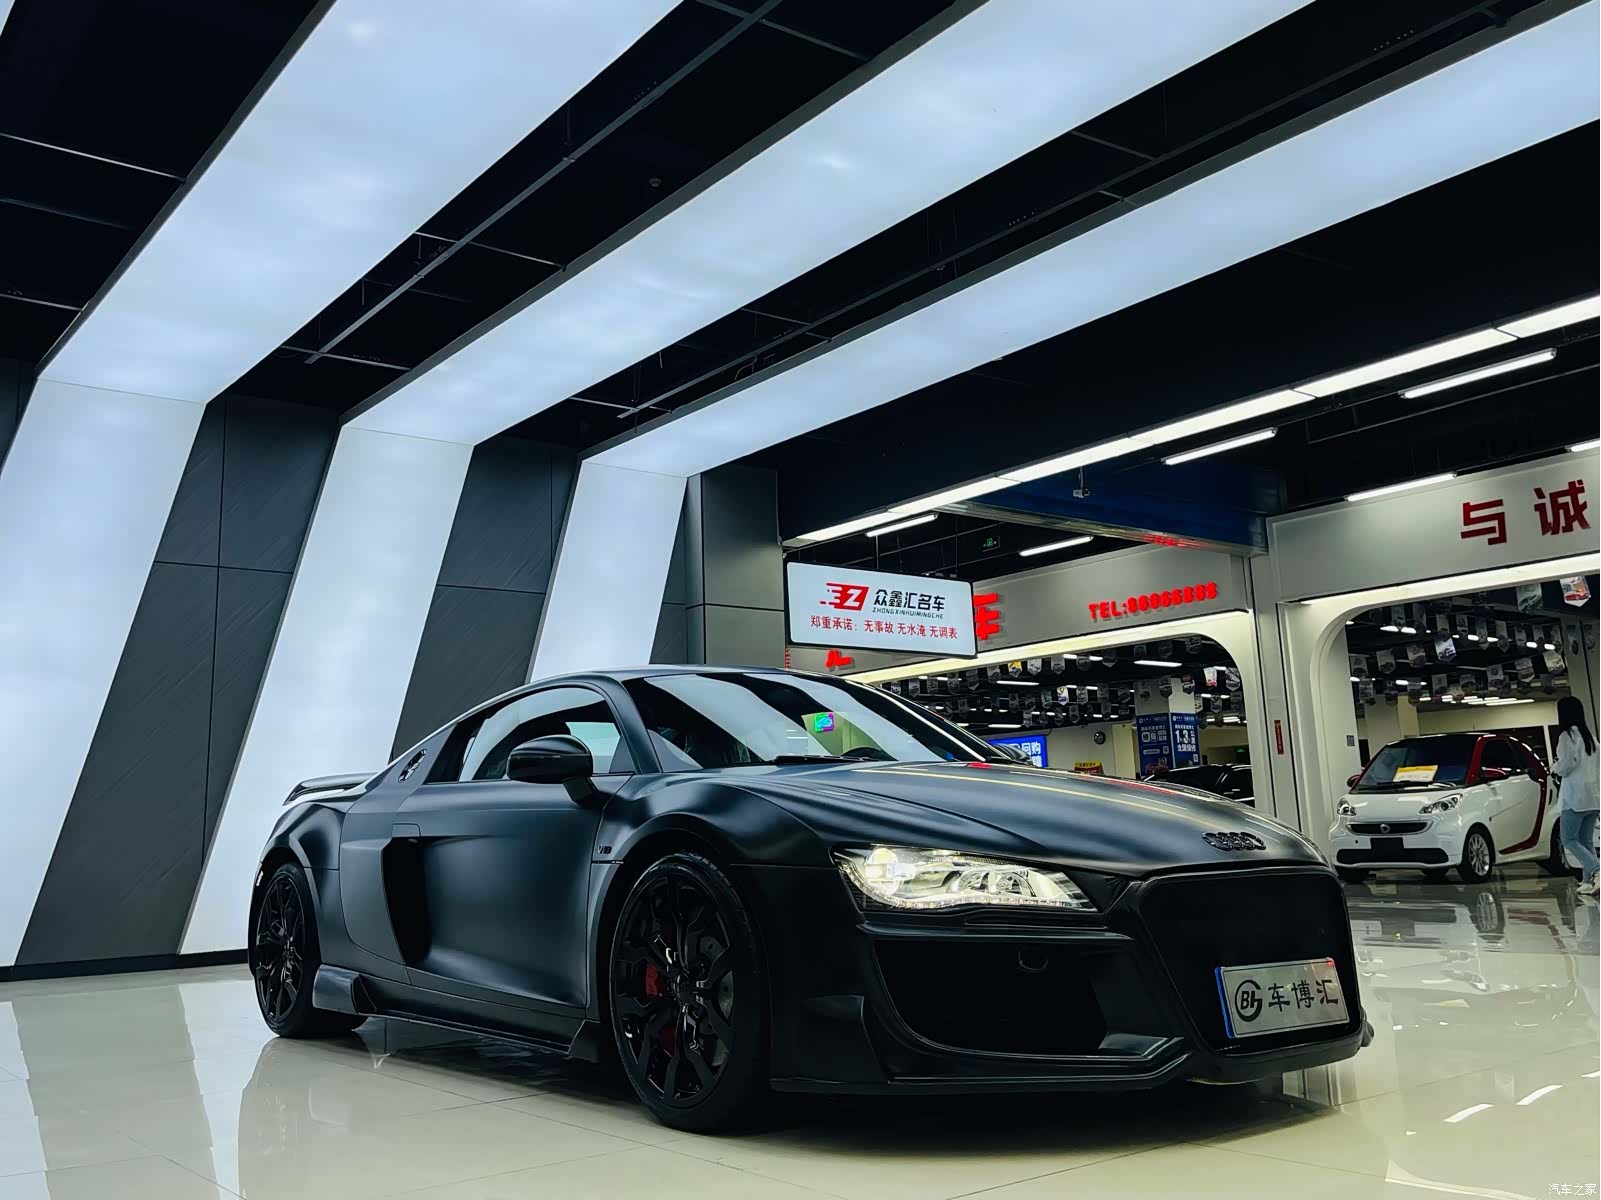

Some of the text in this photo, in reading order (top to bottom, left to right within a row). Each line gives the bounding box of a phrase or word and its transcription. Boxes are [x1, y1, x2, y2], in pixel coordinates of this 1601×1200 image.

[1461, 479, 1591, 545] 与诚
[873, 589, 945, 611] 众鑫汇名车
[872, 606, 944, 620] ZHONGXINHUIMINGCHE
[864, 619, 894, 634] 无事故
[897, 622, 926, 637] 无水淹
[930, 625, 957, 639] 无调表
[1268, 979, 1338, 1013] 车博汇
